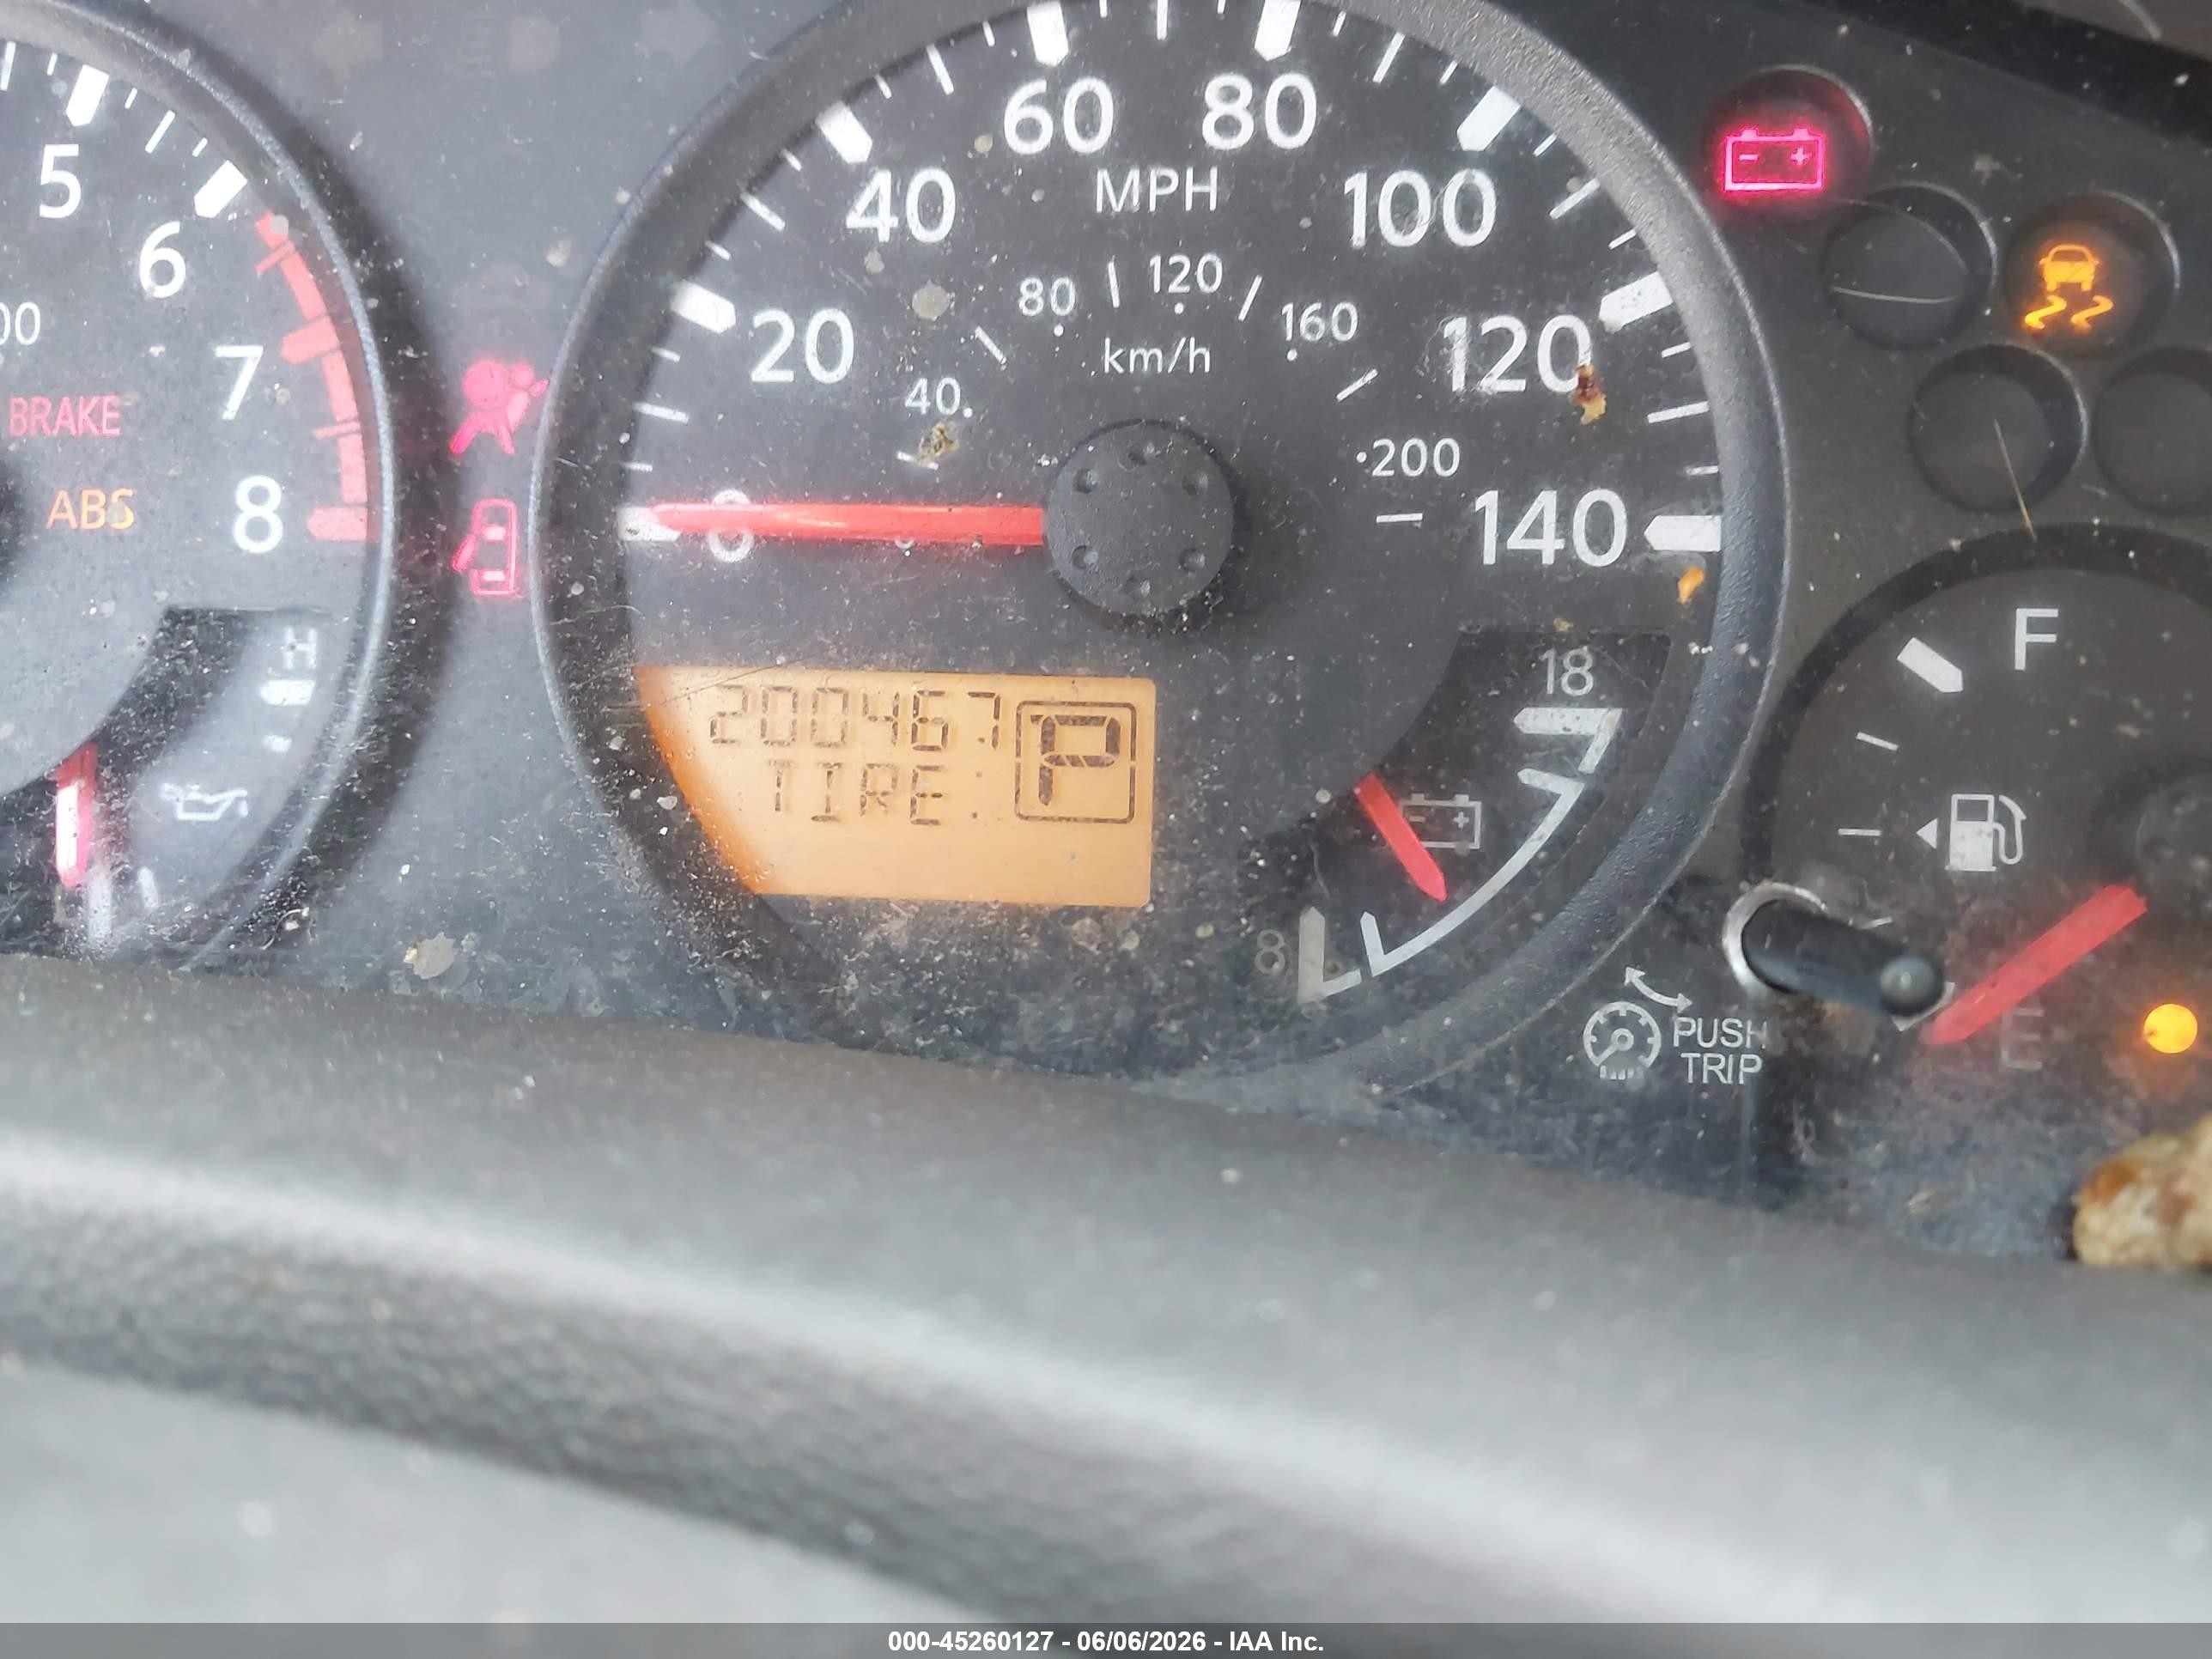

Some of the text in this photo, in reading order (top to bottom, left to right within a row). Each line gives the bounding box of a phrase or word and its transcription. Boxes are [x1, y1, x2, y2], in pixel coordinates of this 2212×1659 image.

[1003, 77, 1115, 155] 60
[1202, 72, 1317, 150] 80
[39, 143, 82, 219] 5
[845, 167, 957, 244] 40
[1095, 167, 1218, 214] MPH
[1343, 168, 1498, 248] 100
[138, 221, 186, 299] 6
[1148, 253, 1224, 296] 120
[1018, 276, 1076, 317] 80
[1280, 302, 1359, 343] 160
[750, 309, 856, 384] 20
[1103, 337, 1212, 375] km/h
[1443, 314, 1593, 393] 120
[214, 345, 263, 421] 7
[904, 378, 961, 416] 40
[9, 393, 122, 438] BRAKE
[1370, 438, 1460, 478] 200
[46, 487, 136, 531] ABS
[233, 474, 284, 555] 8
[1474, 488, 1628, 568] 140
[285, 627, 318, 670] H
[2014, 607, 2059, 671] F
[1540, 647, 1595, 697] 18
[709, 685, 1001, 752] 200467
[1030, 714, 1121, 805] P
[1255, 928, 1286, 975] 8
[1673, 1017, 1767, 1049] PUSH
[2000, 1007, 2045, 1073] E
[1680, 1052, 1763, 1085] TRIP
